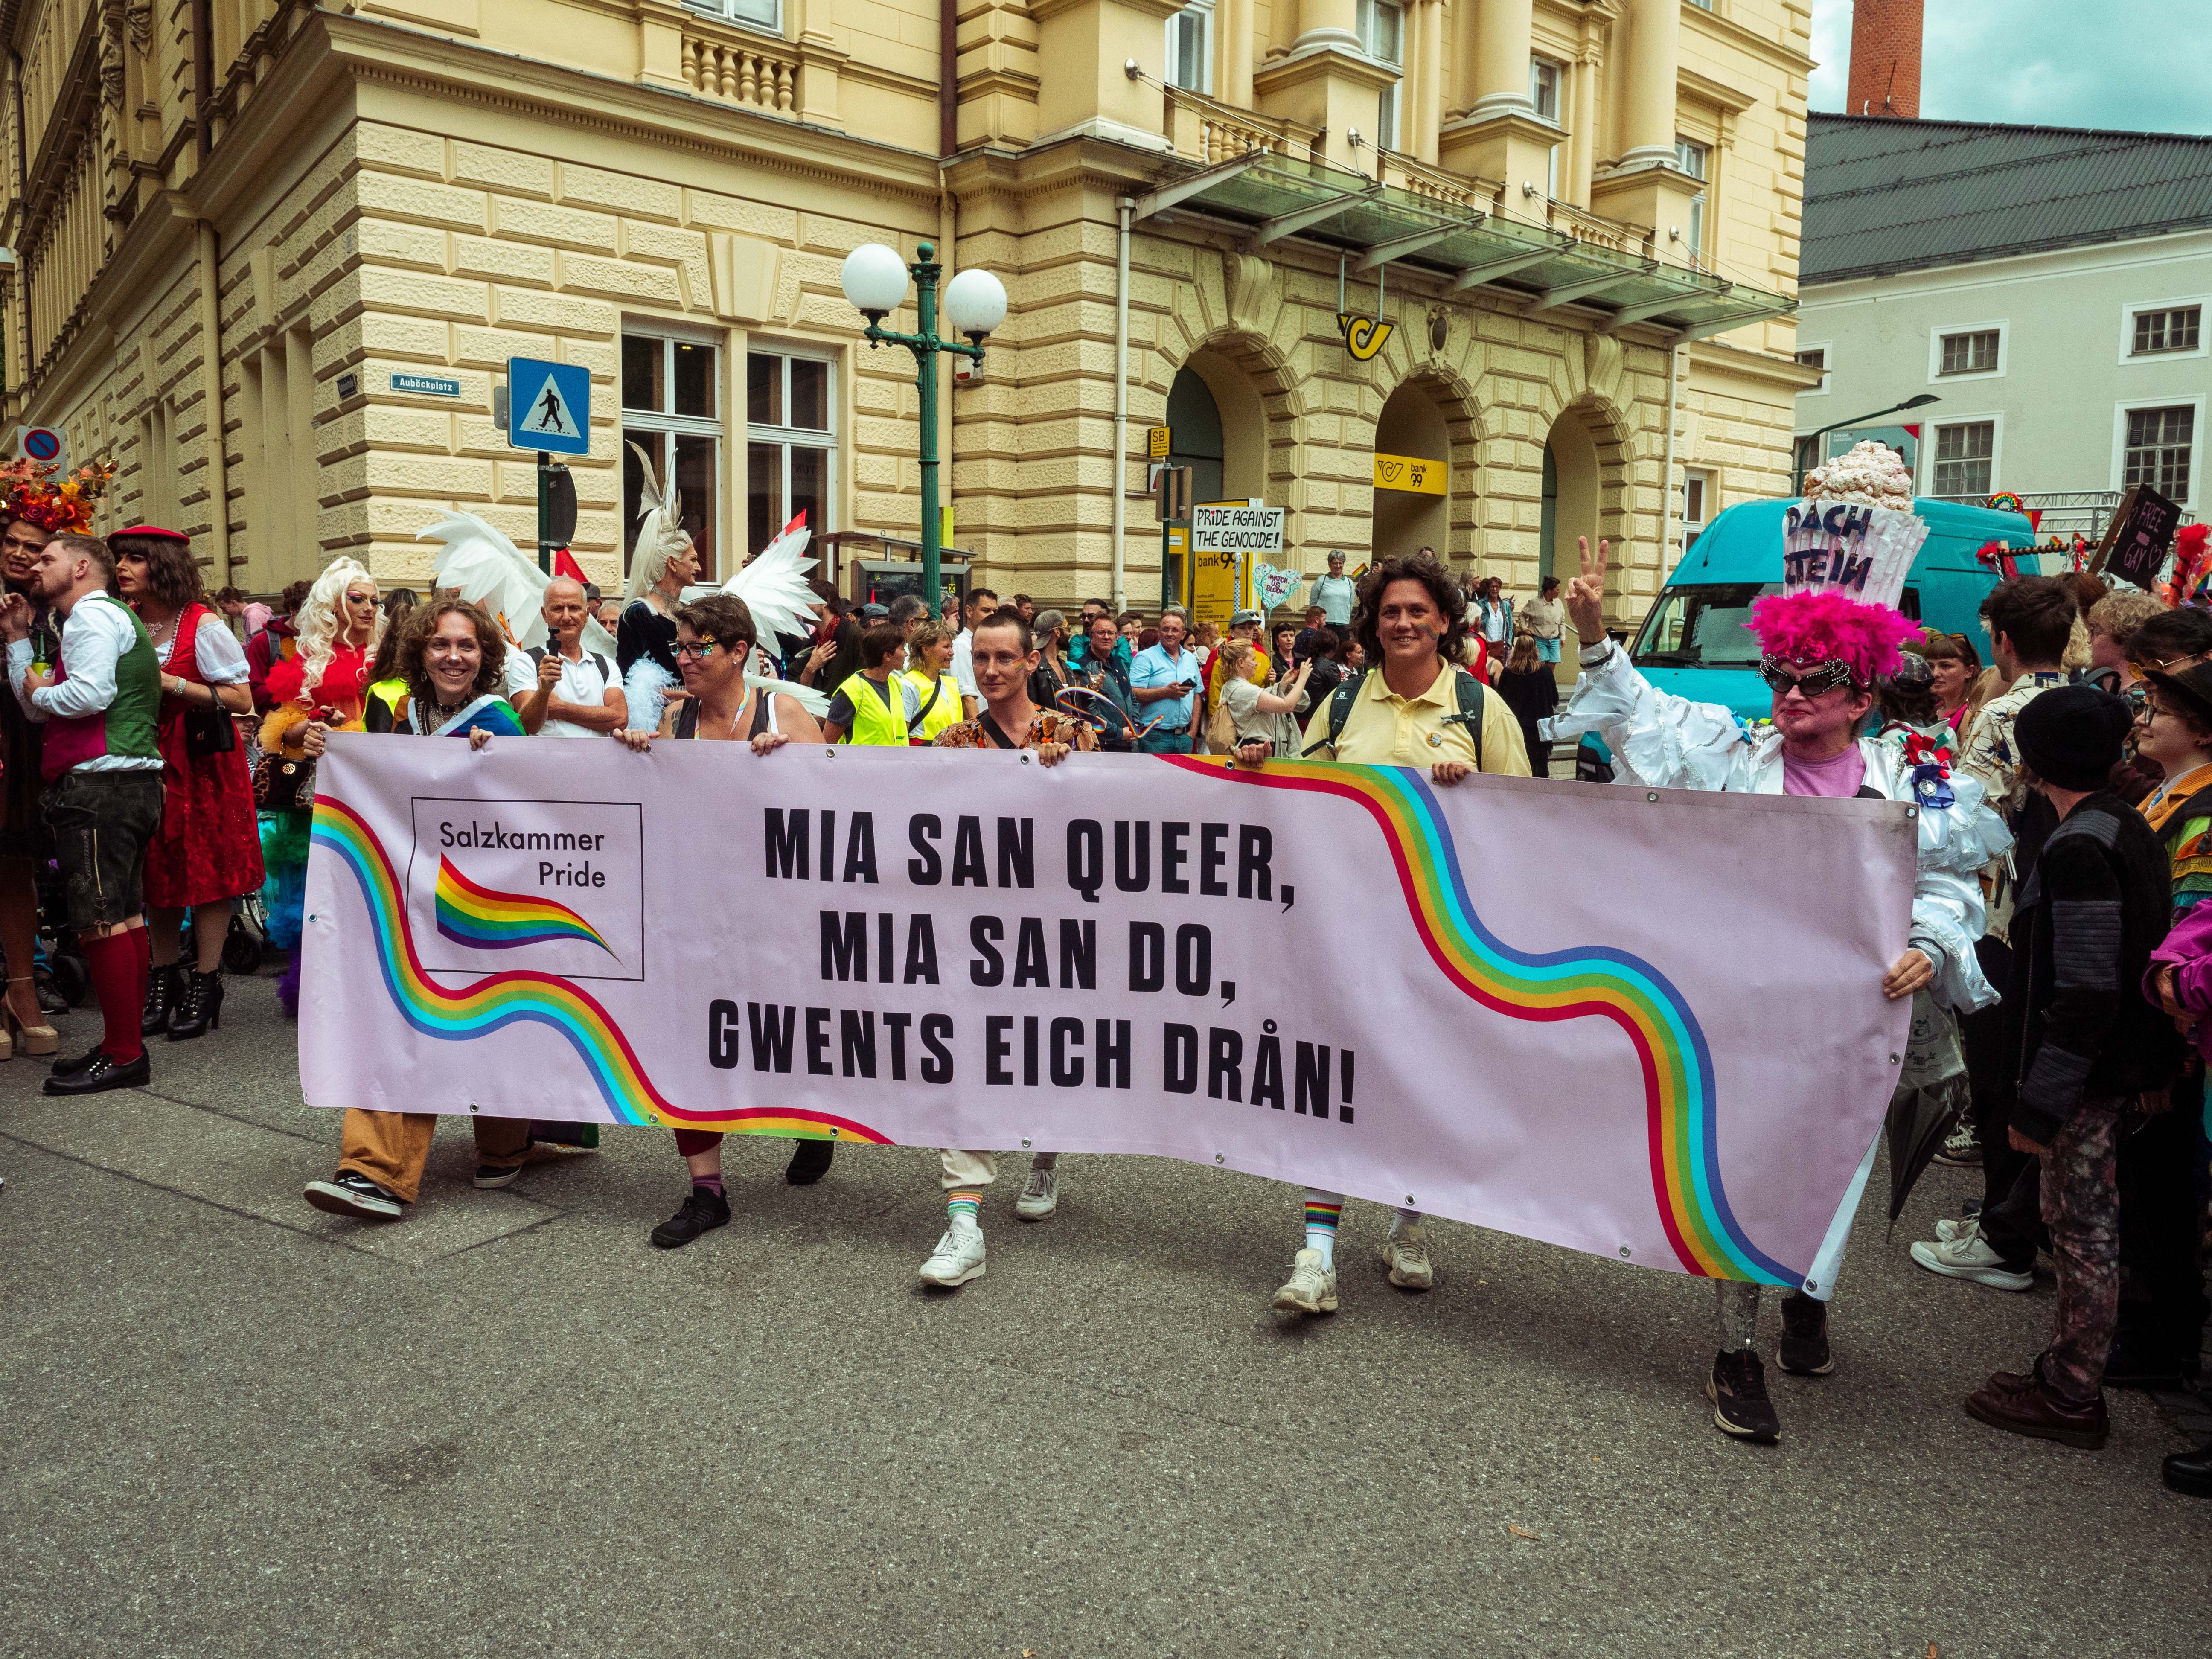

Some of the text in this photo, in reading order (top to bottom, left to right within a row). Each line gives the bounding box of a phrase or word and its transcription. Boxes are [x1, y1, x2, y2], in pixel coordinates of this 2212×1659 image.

[400, 378, 453, 392] Auböckplatz
[1153, 431, 1165, 442] SB
[1411, 463, 1427, 473] bank
[1410, 473, 1423, 487] 99
[1232, 510, 1281, 527] AGAINST
[1785, 501, 1873, 541] DACH
[2137, 501, 2167, 533] FREE
[1196, 531, 1280, 548] THE GENOCIDE!
[1198, 553, 1219, 567] bank
[2124, 543, 2147, 573] GAY
[1269, 574, 1288, 584] WATCH
[1266, 585, 1285, 594] BLOOM
[440, 820, 605, 851] Salzkammer
[764, 807, 1295, 914] MIA SAN QUEER,
[539, 860, 605, 888] Pride
[820, 910, 1236, 1009] MIA SAN DO,
[708, 999, 1355, 1125] GWENTS EICH DRÅN!
